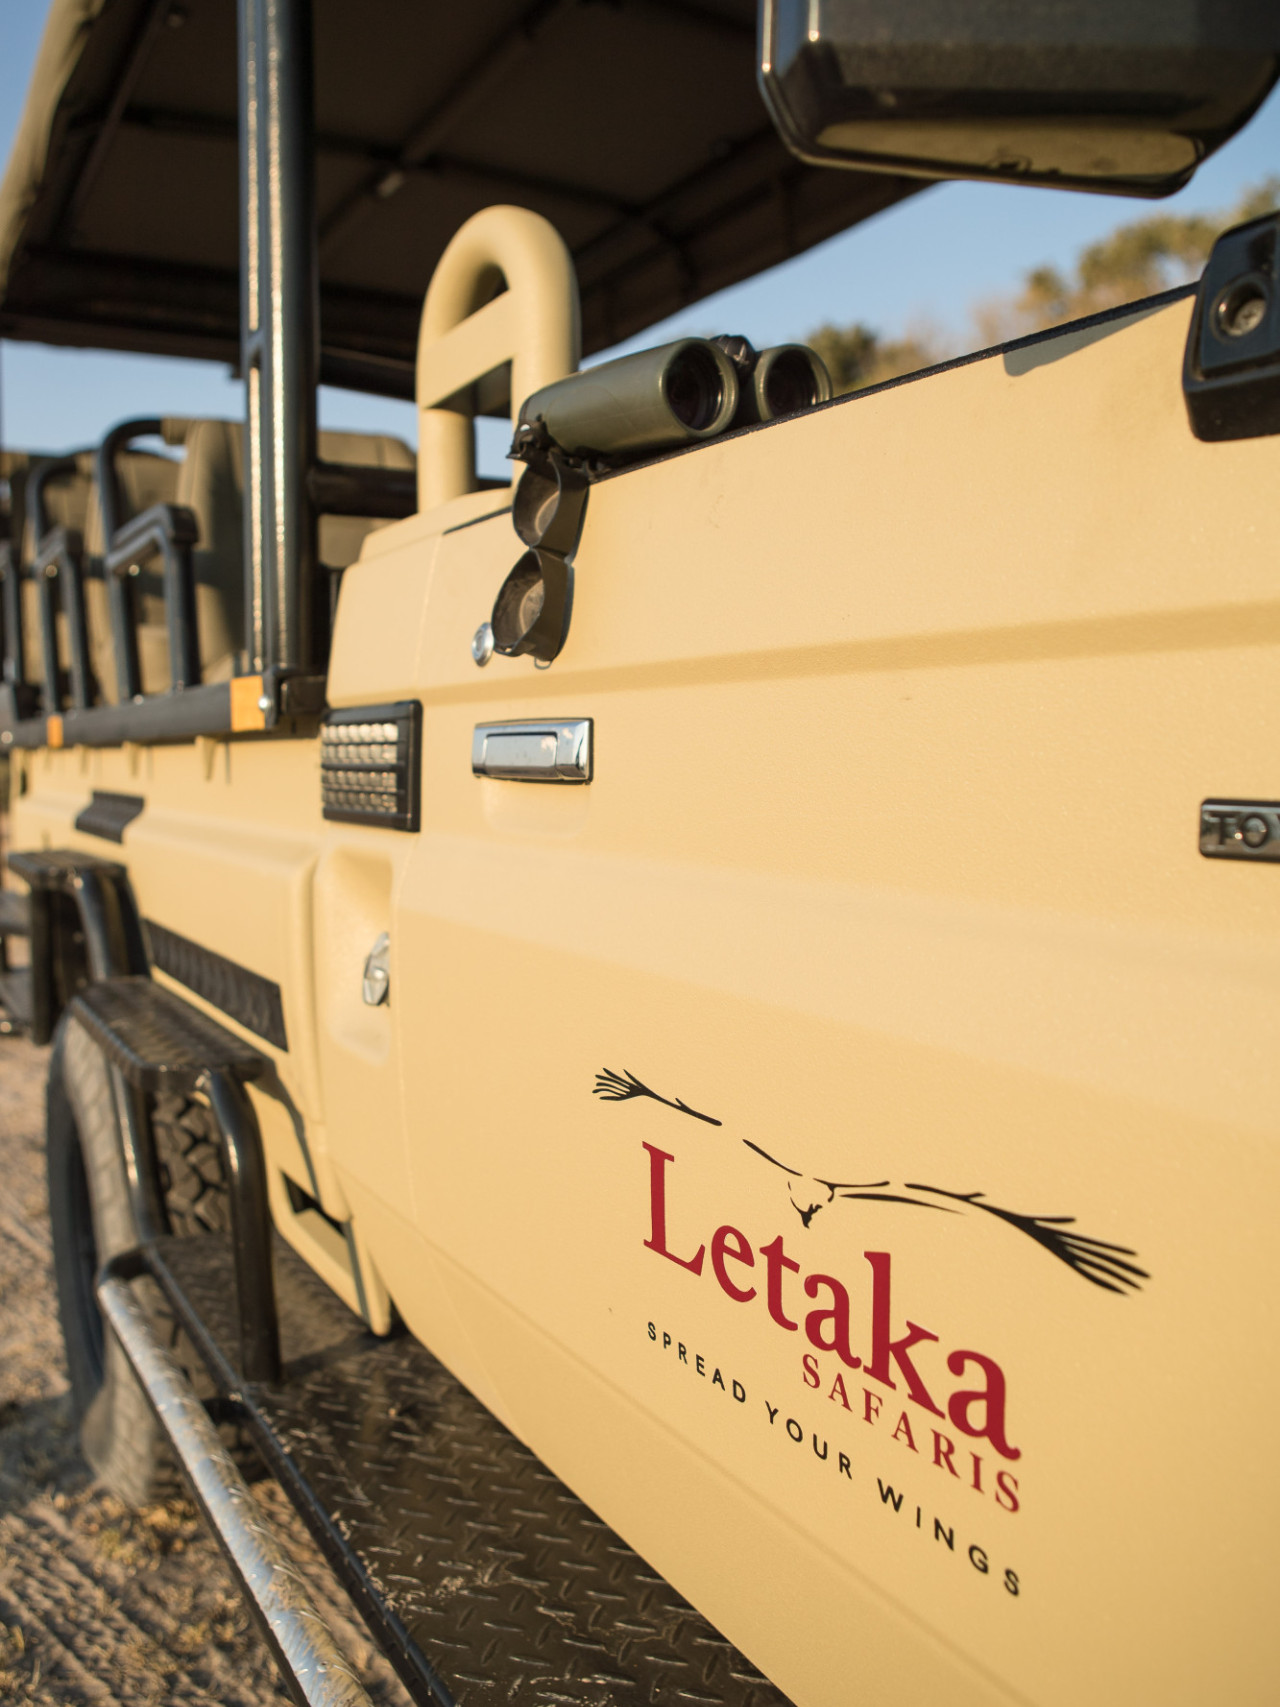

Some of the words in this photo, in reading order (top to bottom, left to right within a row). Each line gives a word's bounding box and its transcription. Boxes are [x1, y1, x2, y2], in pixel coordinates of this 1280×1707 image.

[1207, 810, 1280, 849] TO
[641, 1140, 1022, 1462] Letaka
[646, 1320, 747, 1403] SPREAD
[764, 1399, 853, 1480] YOUR
[876, 1477, 1020, 1598] WINGS
[801, 1353, 1021, 1513] SAFARIS
